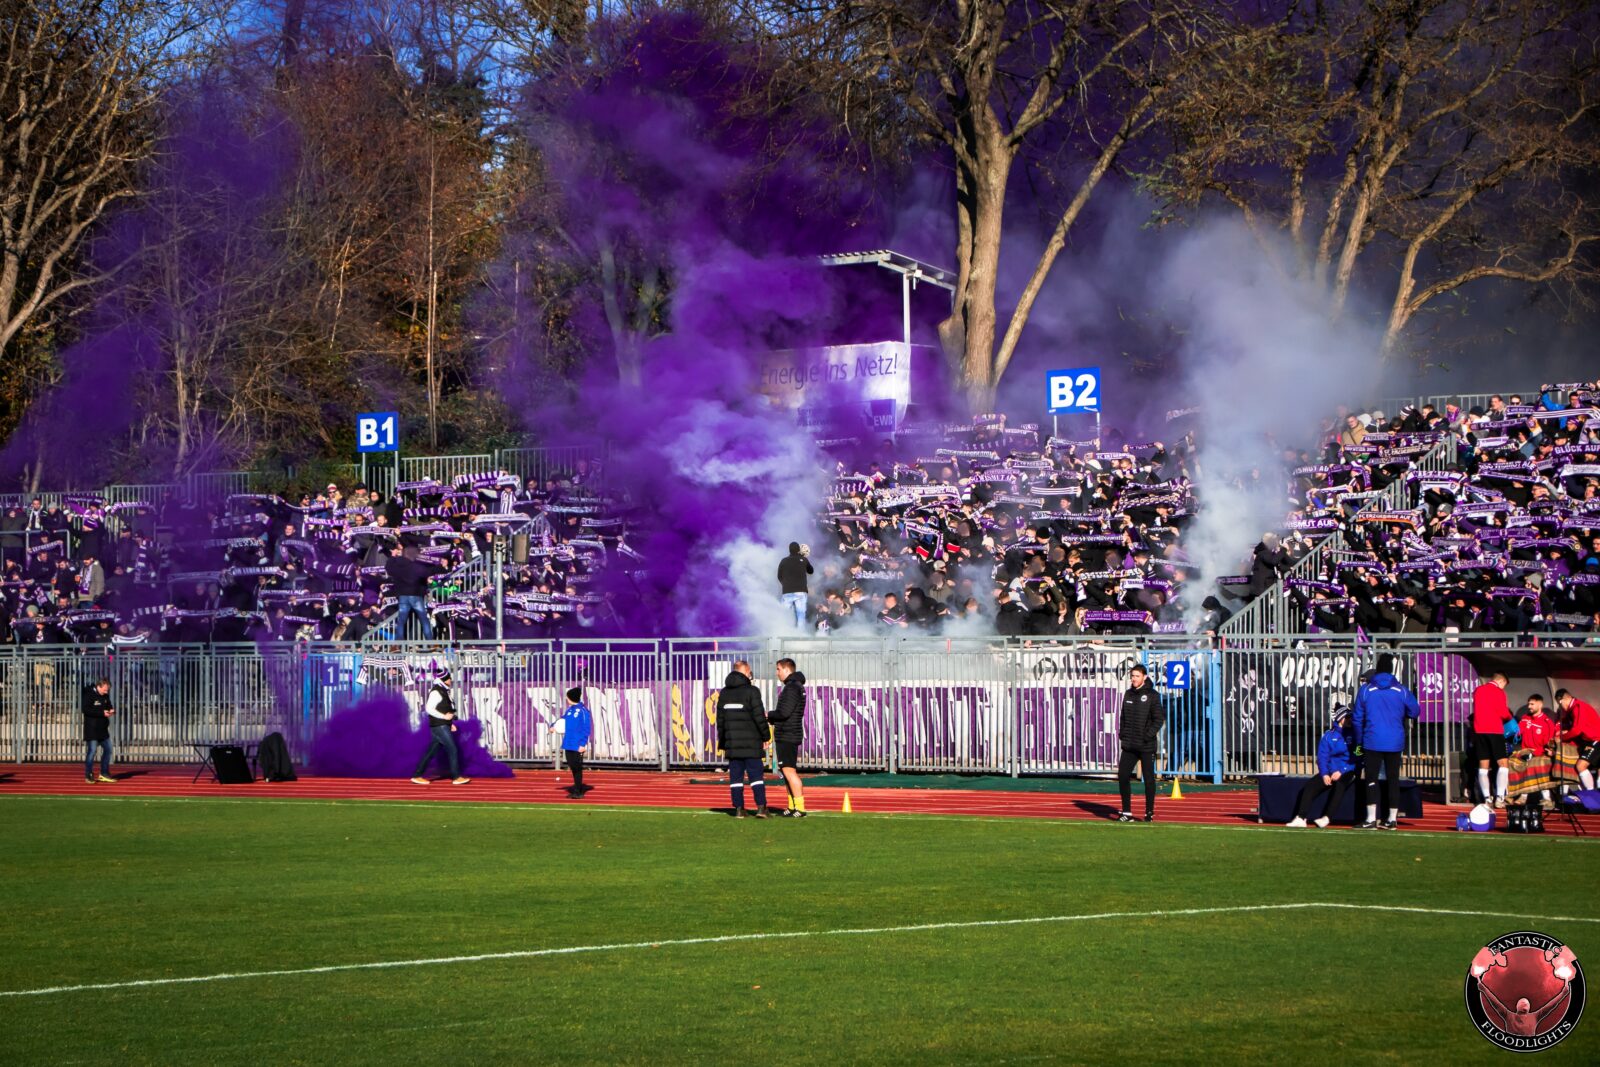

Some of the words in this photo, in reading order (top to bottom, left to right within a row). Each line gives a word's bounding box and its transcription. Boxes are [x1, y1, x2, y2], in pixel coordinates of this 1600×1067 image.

[761, 363, 819, 390] Energie
[825, 359, 848, 383] ins
[855, 353, 898, 377] Netz!
[1050, 374, 1097, 408] B2
[360, 417, 394, 447] B1
[326, 665, 334, 684] 1
[1173, 663, 1185, 686] 2
